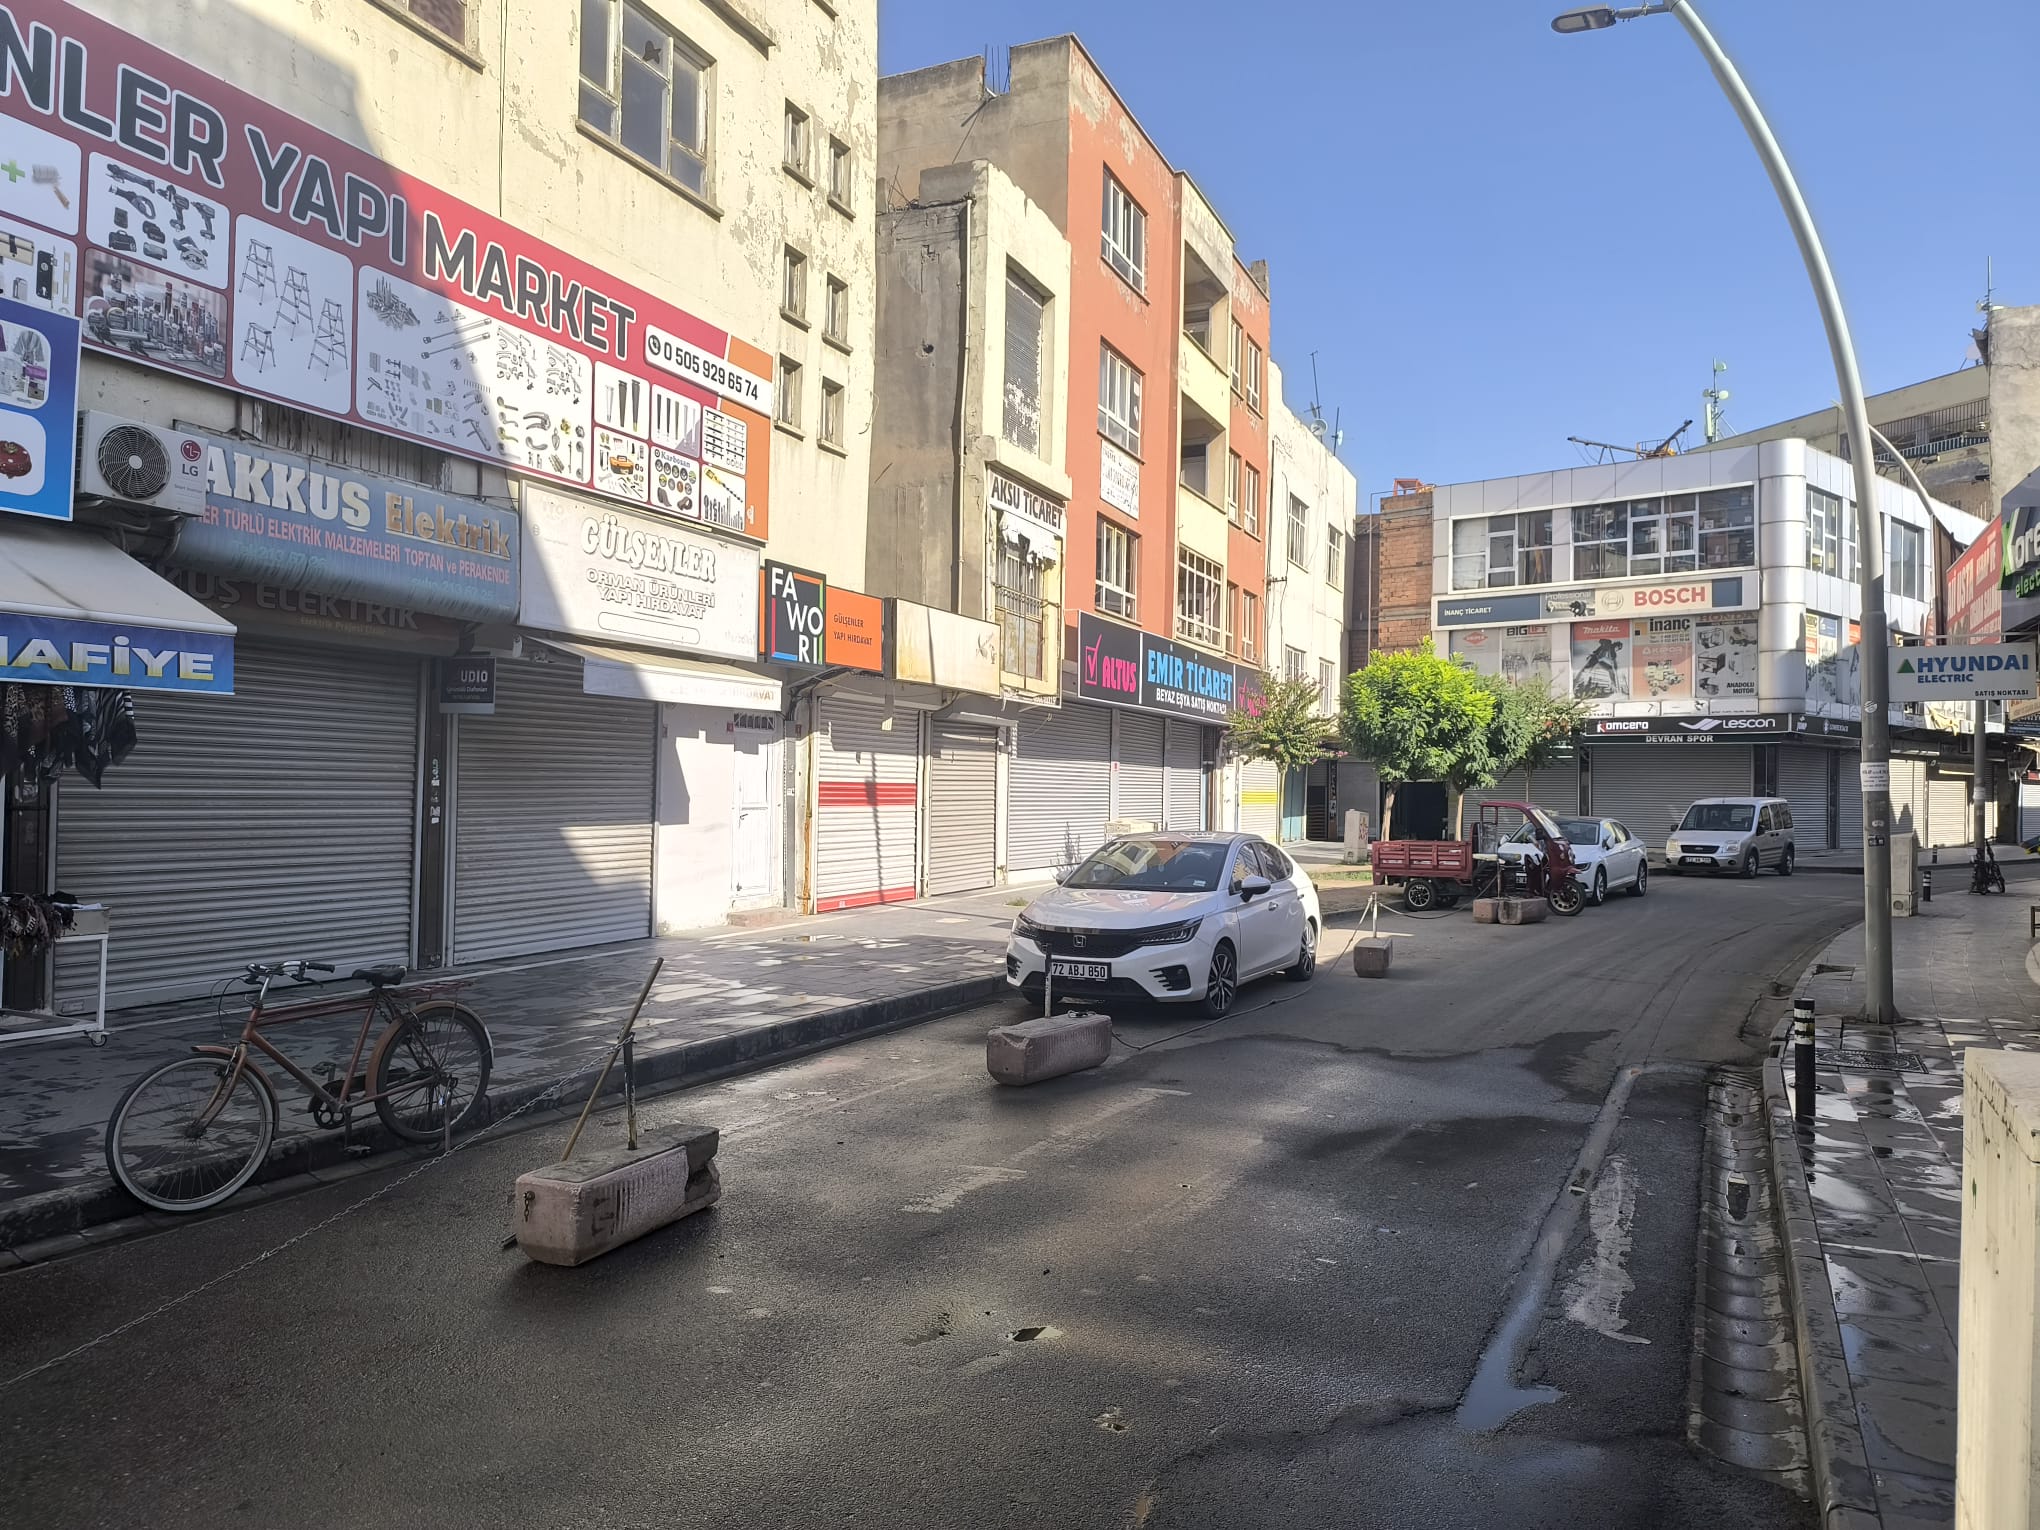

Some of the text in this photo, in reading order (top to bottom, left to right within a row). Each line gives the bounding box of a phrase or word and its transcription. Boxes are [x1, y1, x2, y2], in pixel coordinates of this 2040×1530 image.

[245, 123, 407, 266] YAPI
[423, 210, 636, 360] MARKET
[663, 341, 759, 401] 0 505 929 65 74
[182, 463, 199, 477] LG
[990, 477, 1063, 530] AKSU TİCARET
[385, 490, 511, 558] Elektrik
[223, 508, 264, 535] TÜRLÜ
[268, 518, 322, 547] ELEKTRİK
[324, 530, 400, 562] MALZEMELERİ
[404, 547, 444, 572] TOPTAN
[446, 560, 457, 575] ve
[459, 560, 510, 584] PERAKENDE
[581, 513, 716, 583] GÜLŞENLER
[586, 567, 715, 608] ORMAN ÜRÜNLERİ
[771, 566, 798, 602] FA
[1634, 587, 1706, 607] BOSCH
[598, 584, 706, 619] YAPI HIRDAVAT
[1444, 606, 1493, 617] İNANÇ TİCARET
[785, 600, 824, 635] WO
[833, 613, 864, 628] GÜLŞENLER
[1583, 625, 1621, 635] makita
[1649, 618, 1692, 633] inanç
[1701, 612, 1757, 623] HONDA
[798, 635, 819, 665] RI
[833, 631, 873, 646] YAPI HIRDAVAT
[1102, 655, 1137, 693] ALTUS
[1147, 644, 1233, 702] EMİR TİCARET
[1917, 654, 2029, 674] HYUNDAI
[1917, 673, 1974, 684] ELECTRIC
[1156, 687, 1176, 704] BEYAZ
[1176, 693, 1191, 710] EŞYA
[1191, 696, 1206, 713] SATIŞ
[1997, 689, 2029, 697] NOKTASI
[1645, 735, 1714, 743] DEVRAN SPOR
[1052, 963, 1105, 977] 72 ABJ 850
